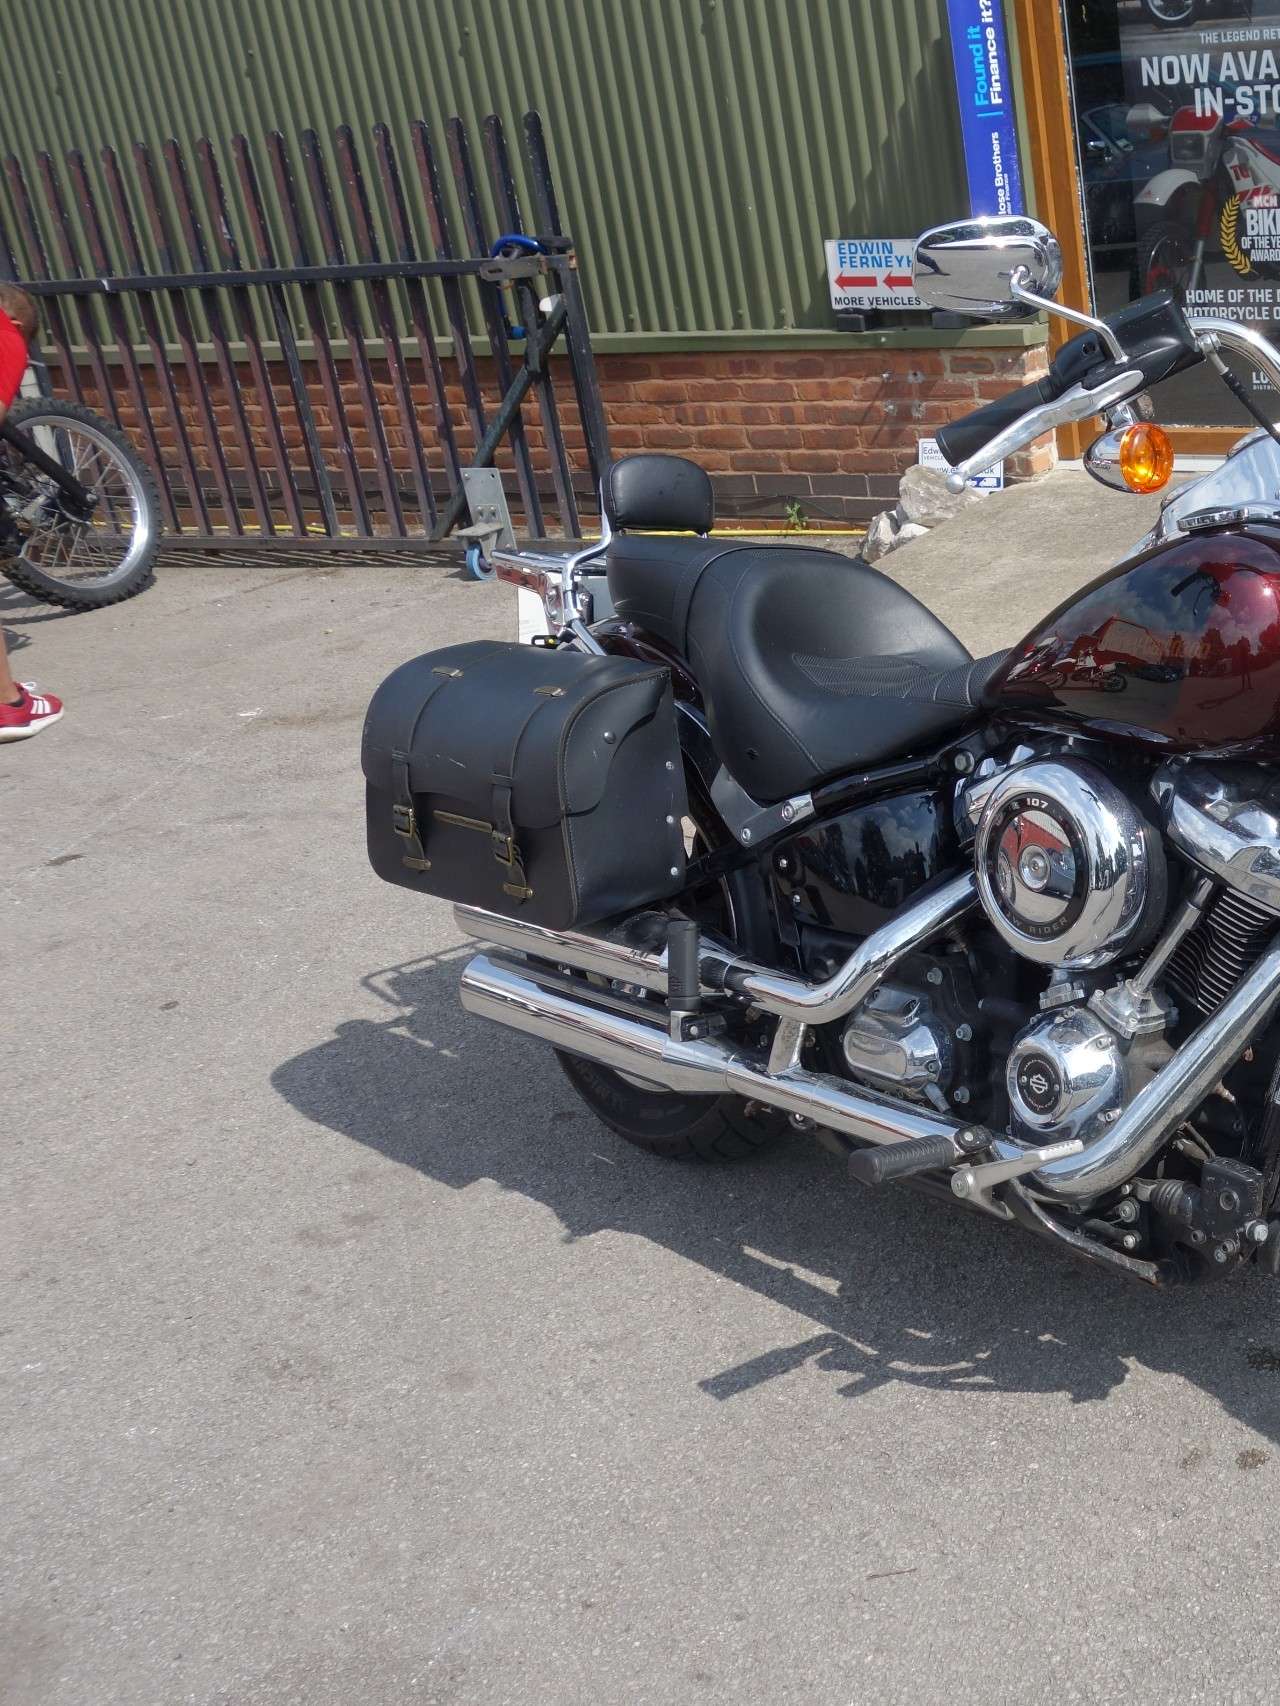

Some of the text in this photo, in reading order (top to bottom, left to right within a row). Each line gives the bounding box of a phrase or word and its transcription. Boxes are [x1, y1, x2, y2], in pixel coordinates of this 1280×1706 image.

[1200, 32, 1219, 44] THE
[1221, 30, 1260, 43] LEGEND
[979, 0, 1003, 104] Finance it?
[968, 25, 989, 105] Found it
[1141, 53, 1210, 86] NOW
[992, 132, 1007, 215] lose Brothers
[837, 242, 893, 255] EDWIN
[1241, 237, 1252, 249] OF
[1254, 236, 1271, 249] THE
[839, 256, 913, 268] FERNEYH
[834, 296, 921, 306] MORE VEHICLES
[1185, 289, 1224, 304] HOME
[1228, 289, 1244, 303] OF
[1248, 289, 1273, 303] THE
[1182, 306, 1270, 320] MOTORCYCLE
[923, 446, 940, 455] Edw
[1027, 798, 1049, 809] 107
[1029, 916, 1069, 935] RIDER
